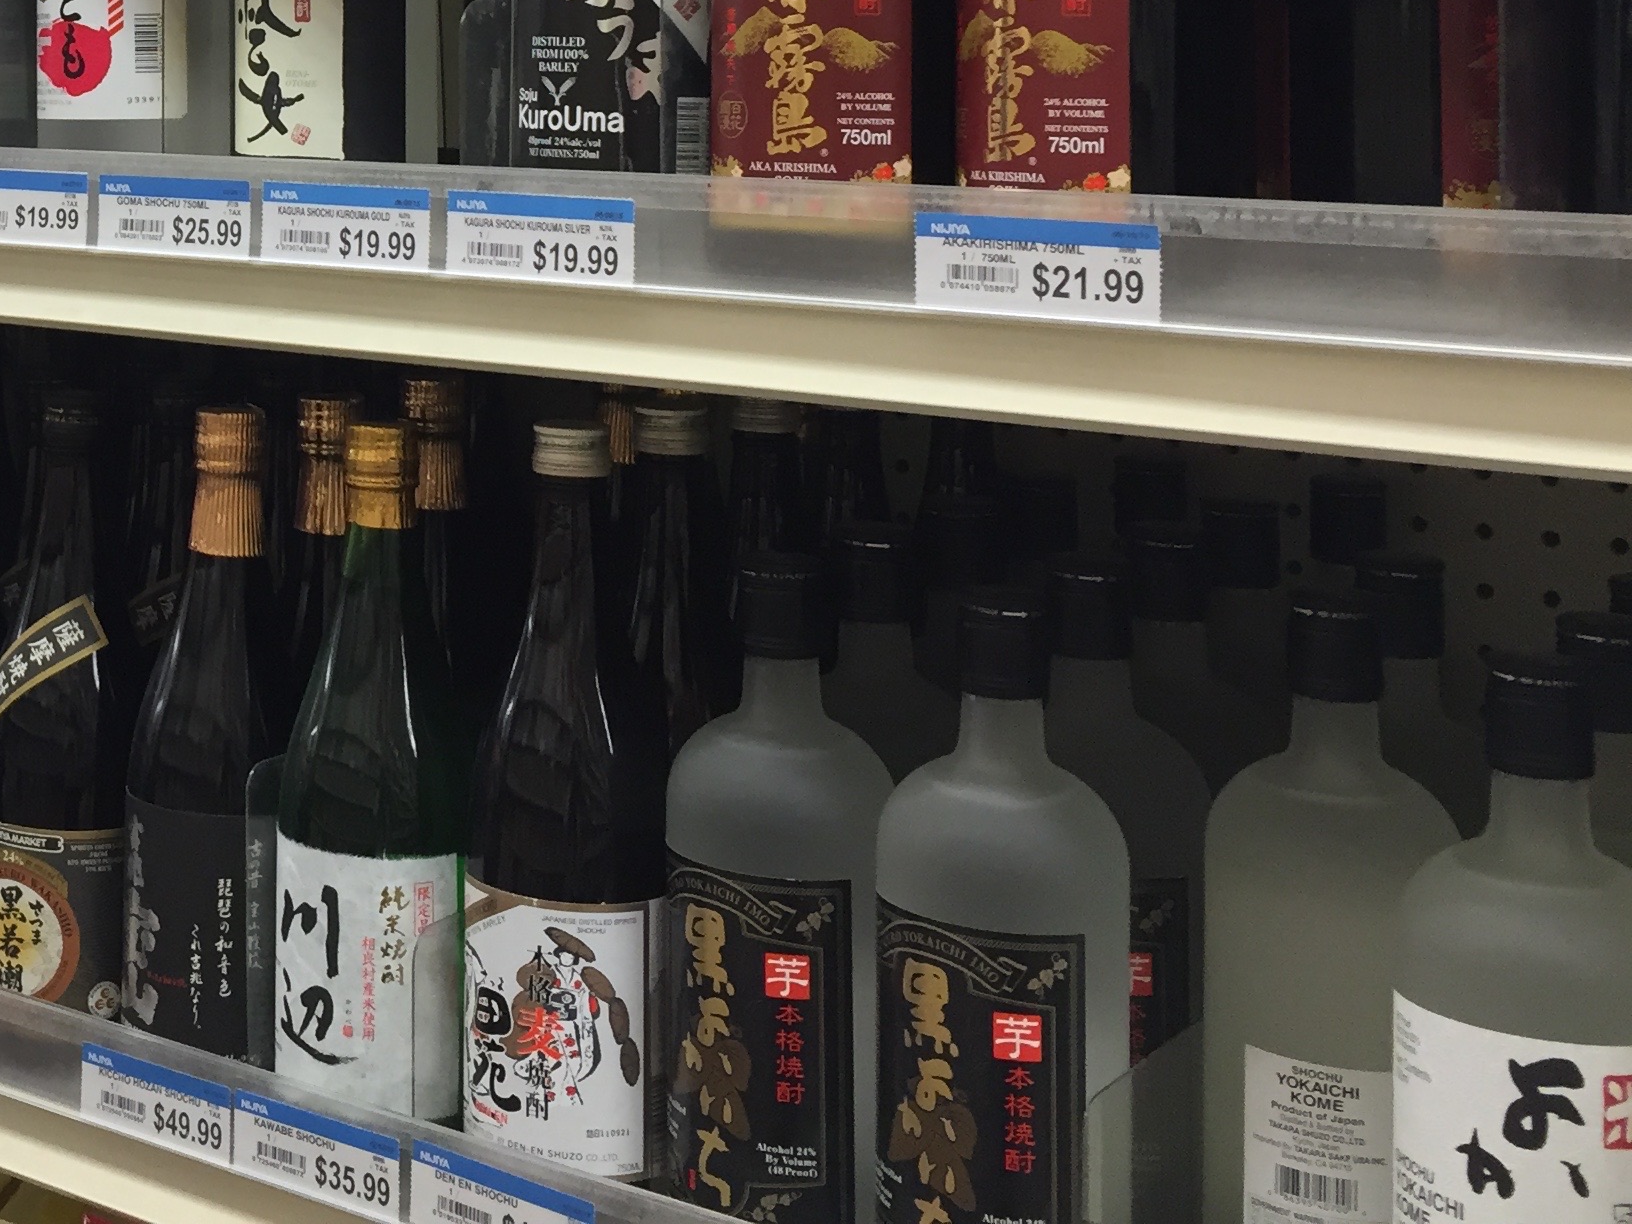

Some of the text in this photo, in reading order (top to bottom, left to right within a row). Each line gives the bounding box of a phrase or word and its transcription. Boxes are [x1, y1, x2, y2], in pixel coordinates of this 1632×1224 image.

[531, 35, 586, 48] DISTILLED
[538, 61, 581, 74] BARLEY
[519, 86, 538, 103] Soju
[854, 91, 896, 102] ALCOHOL
[1062, 98, 1110, 108] ALCOHOL
[855, 102, 893, 113] VOLUME
[1064, 108, 1106, 119] VOLUME
[518, 103, 626, 134] KuroUma
[840, 128, 893, 147] 750ml
[1048, 136, 1106, 155] 750ml
[749, 161, 838, 176] AKA KIRISHIMA
[988, 170, 1046, 184] KIRISHIMA
[116, 196, 182, 209] GOMA SHOCHU
[456, 198, 489, 212] NIJIYA
[14, 203, 80, 231] $19.99
[277, 205, 391, 222] KAGURA SHOCHU KUROUMA GOLD
[171, 214, 243, 248] $25.99
[464, 217, 592, 235] KAGURA SHOCHU KUROUMA SILVER
[930, 222, 971, 235] NIJIYA
[339, 226, 417, 261] $19.99
[942, 237, 1086, 256] AKAKIRISHIMA 750ML
[533, 238, 620, 277] $19.99
[981, 252, 1016, 264] 750ML
[1031, 261, 1145, 304] $21.99
[14, 833, 48, 848] MARKET
[378, 885, 407, 987] 純米焼酎
[280, 884, 359, 1066] 川辺
[766, 956, 809, 998] 芋
[969, 956, 1001, 984] IMO
[995, 1015, 1042, 1060] 芋
[775, 1004, 806, 1106] 本格焼酎
[1291, 1065, 1344, 1085] SHOCHU
[1276, 1071, 1361, 1101] YOKAICHI
[163, 1085, 202, 1109] SHOCHU
[240, 1097, 269, 1117] NIJIYA
[1289, 1091, 1346, 1114] KOME
[1004, 1066, 1037, 1175] 本格焼酎
[1270, 1099, 1366, 1128] Product Japan
[152, 1101, 223, 1151] $49.99
[252, 1116, 337, 1154] KAWABE SHOCHU
[547, 1149, 584, 1162] SHUZO
[756, 1142, 794, 1156] Alcohol
[419, 1150, 451, 1171] NIJIYA
[780, 1156, 818, 1167] Volume
[314, 1153, 392, 1208] $35.99
[434, 1168, 519, 1210] DEN SHOCHU
